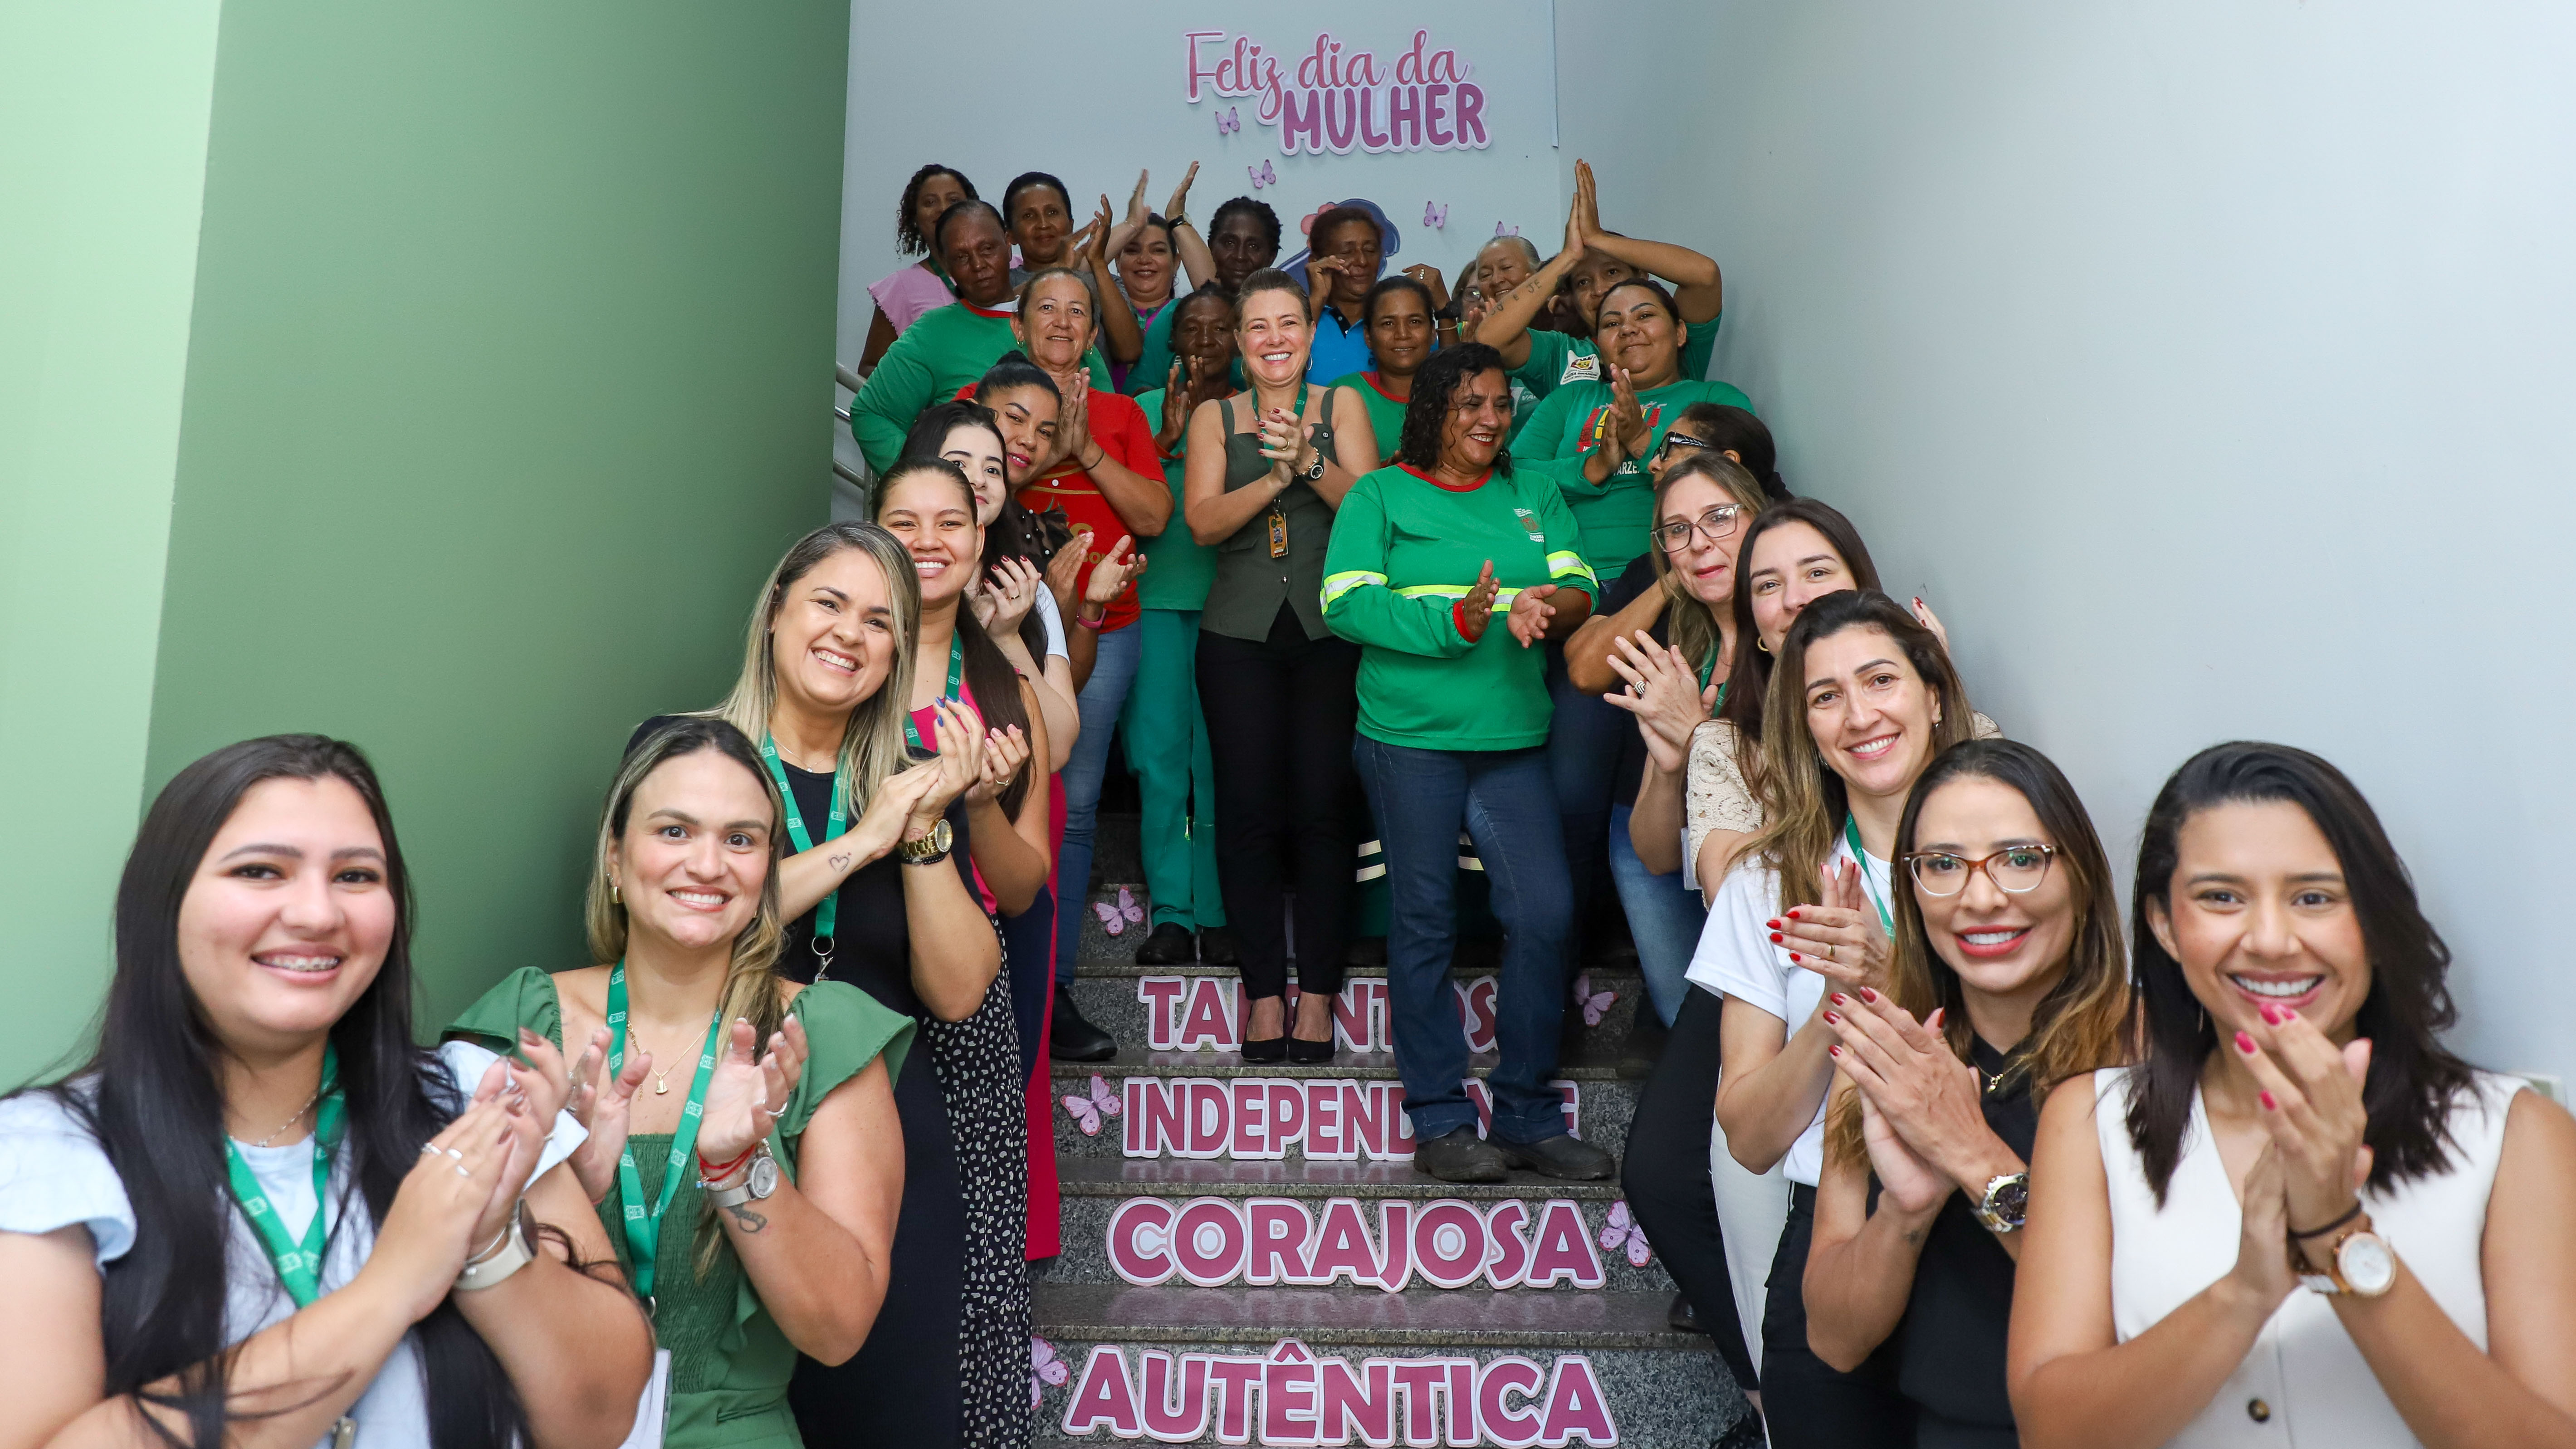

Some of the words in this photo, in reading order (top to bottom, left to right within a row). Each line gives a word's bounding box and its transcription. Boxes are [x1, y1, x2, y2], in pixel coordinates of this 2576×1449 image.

[1185, 31, 1285, 120] Feliz
[1298, 33, 1385, 89] dia
[1395, 30, 1469, 86] da
[1283, 83, 1487, 149] MULHER
[1122, 1082, 1576, 1154] INDEPEND
[1112, 1203, 1599, 1288] CORAJOSA
[1069, 1341, 1614, 1442] AUTÊNTICA
